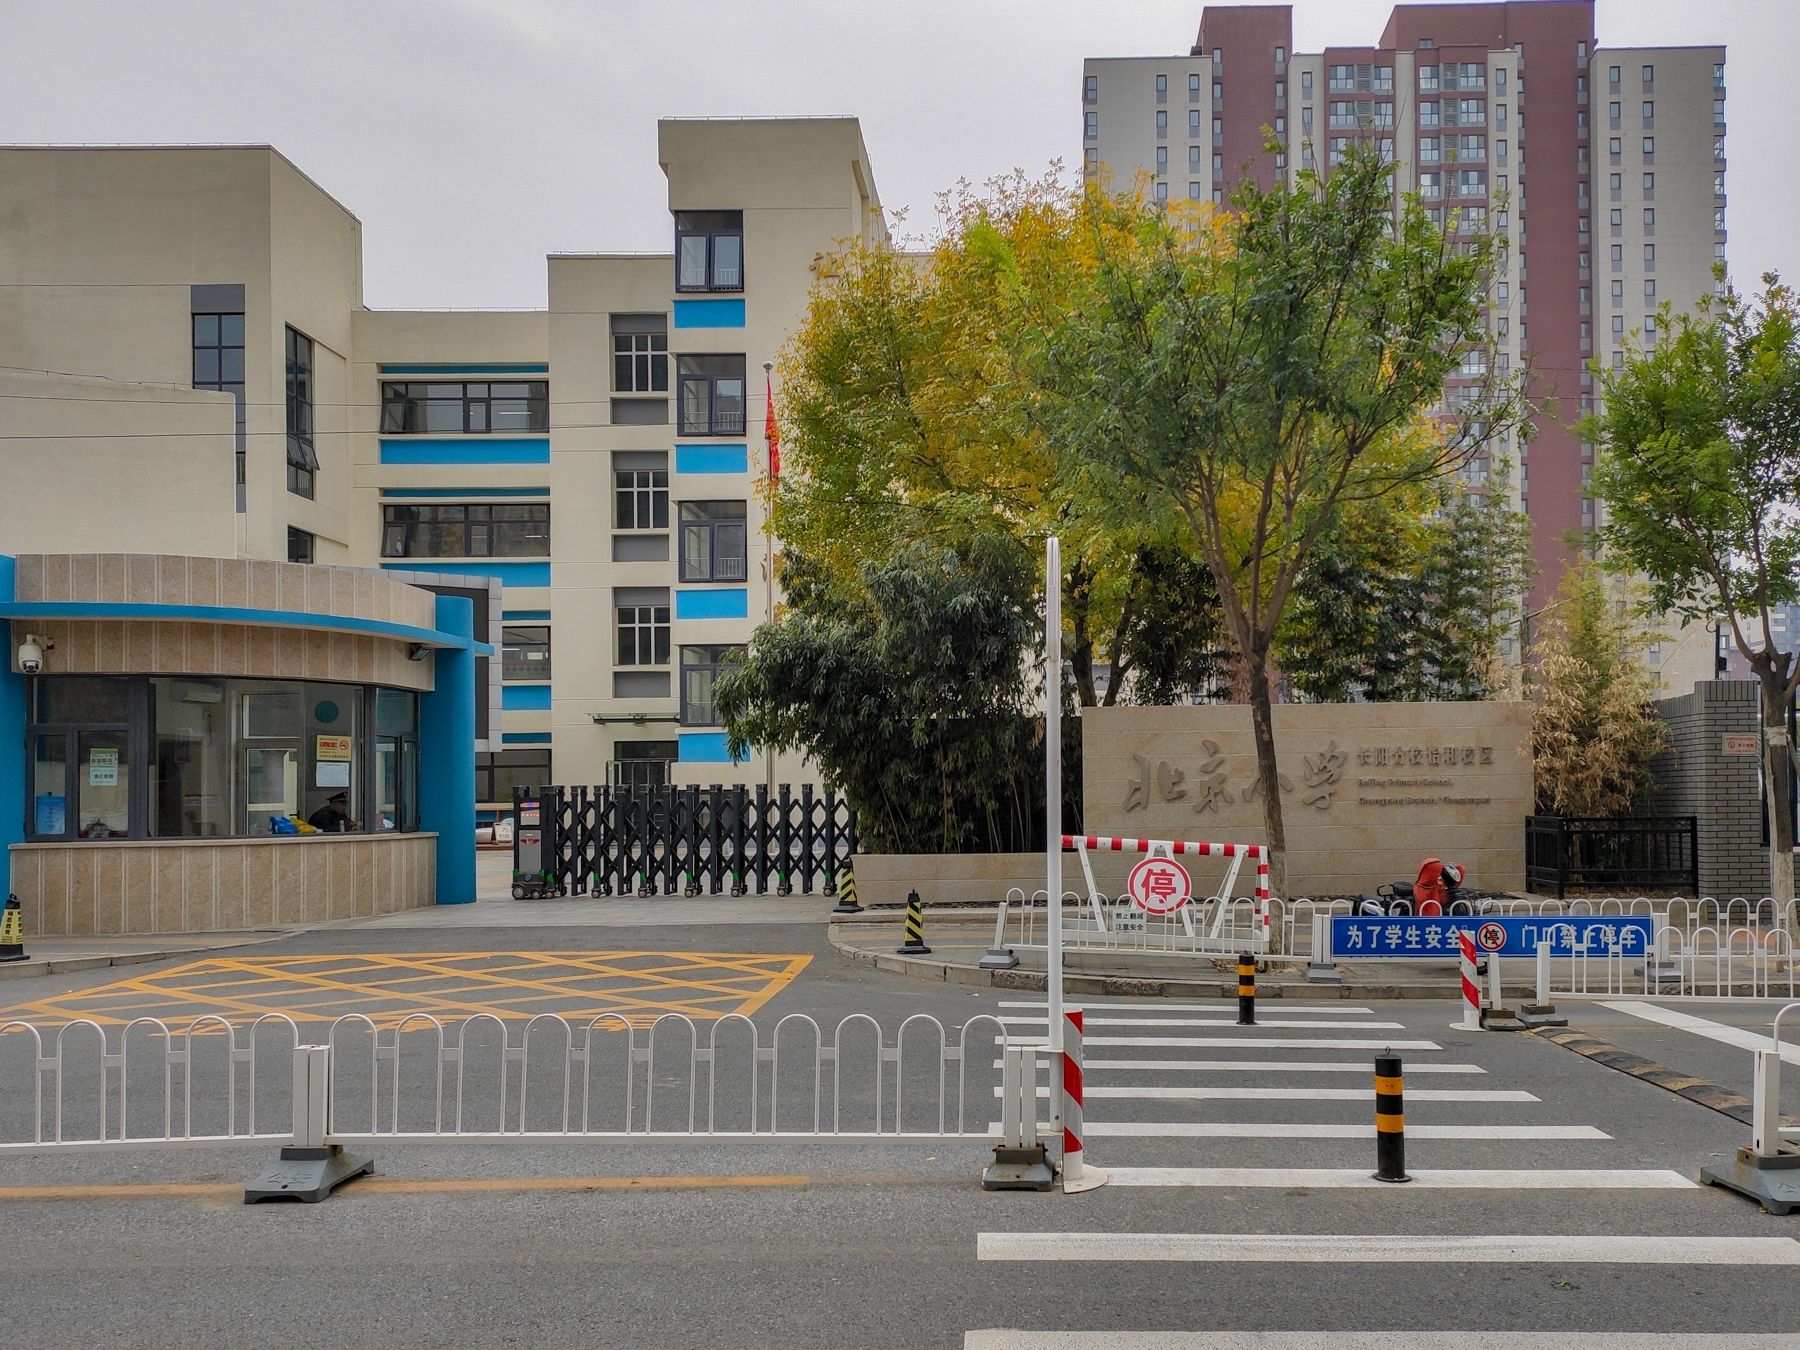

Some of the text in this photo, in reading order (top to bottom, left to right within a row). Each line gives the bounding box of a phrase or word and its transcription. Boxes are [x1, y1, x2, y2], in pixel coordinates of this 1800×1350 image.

[1122, 739, 1349, 814] 北京小学
[1141, 868, 1177, 904] 停
[1115, 923, 1144, 931] 注意安全
[1347, 923, 1461, 949] 为了学生安全
[1522, 923, 1637, 949] 门口禁止停车
